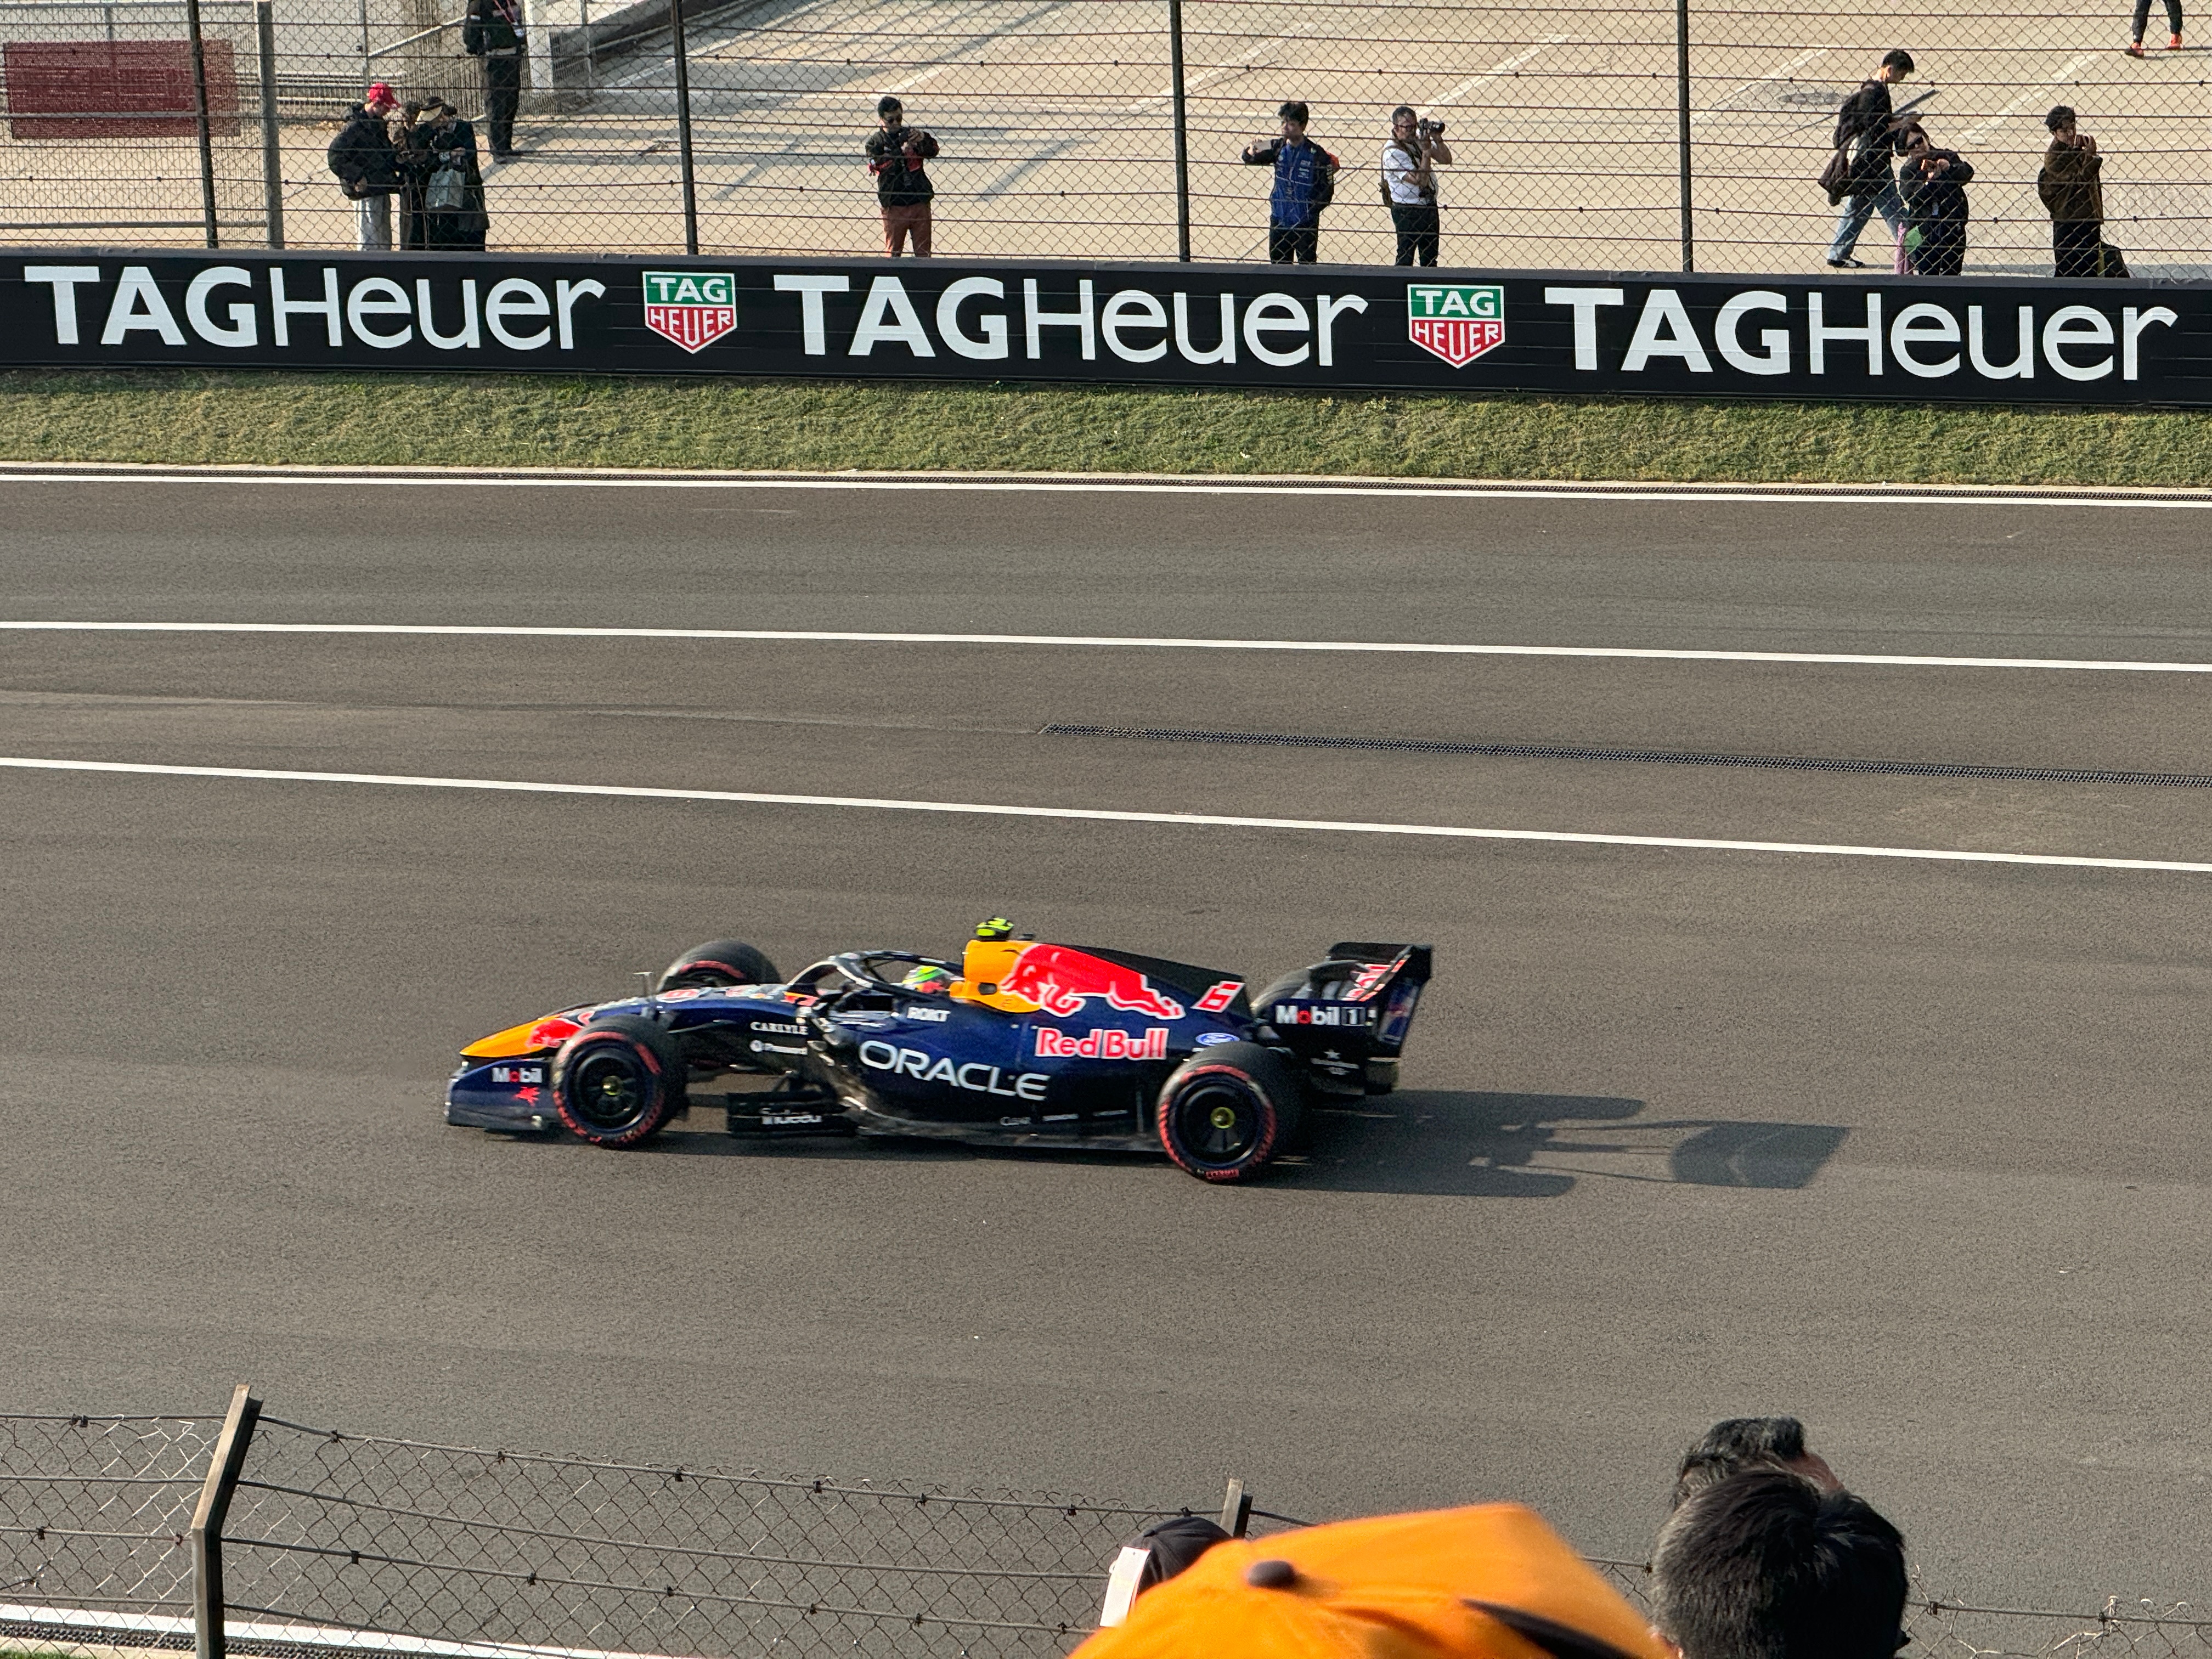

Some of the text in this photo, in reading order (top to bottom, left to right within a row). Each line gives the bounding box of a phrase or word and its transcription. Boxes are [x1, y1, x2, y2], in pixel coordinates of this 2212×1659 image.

[651, 277, 727, 302] TAG
[1416, 290, 1495, 315] TAG
[650, 308, 731, 347] HEUER
[1414, 322, 1499, 361] HEUER
[1194, 982, 1242, 1012] 6
[1276, 1005, 1340, 1026] Mobil
[1037, 1029, 1167, 1059] Red Bull
[492, 1067, 542, 1083] Mobil
[859, 1040, 1051, 1101] ORACLE
